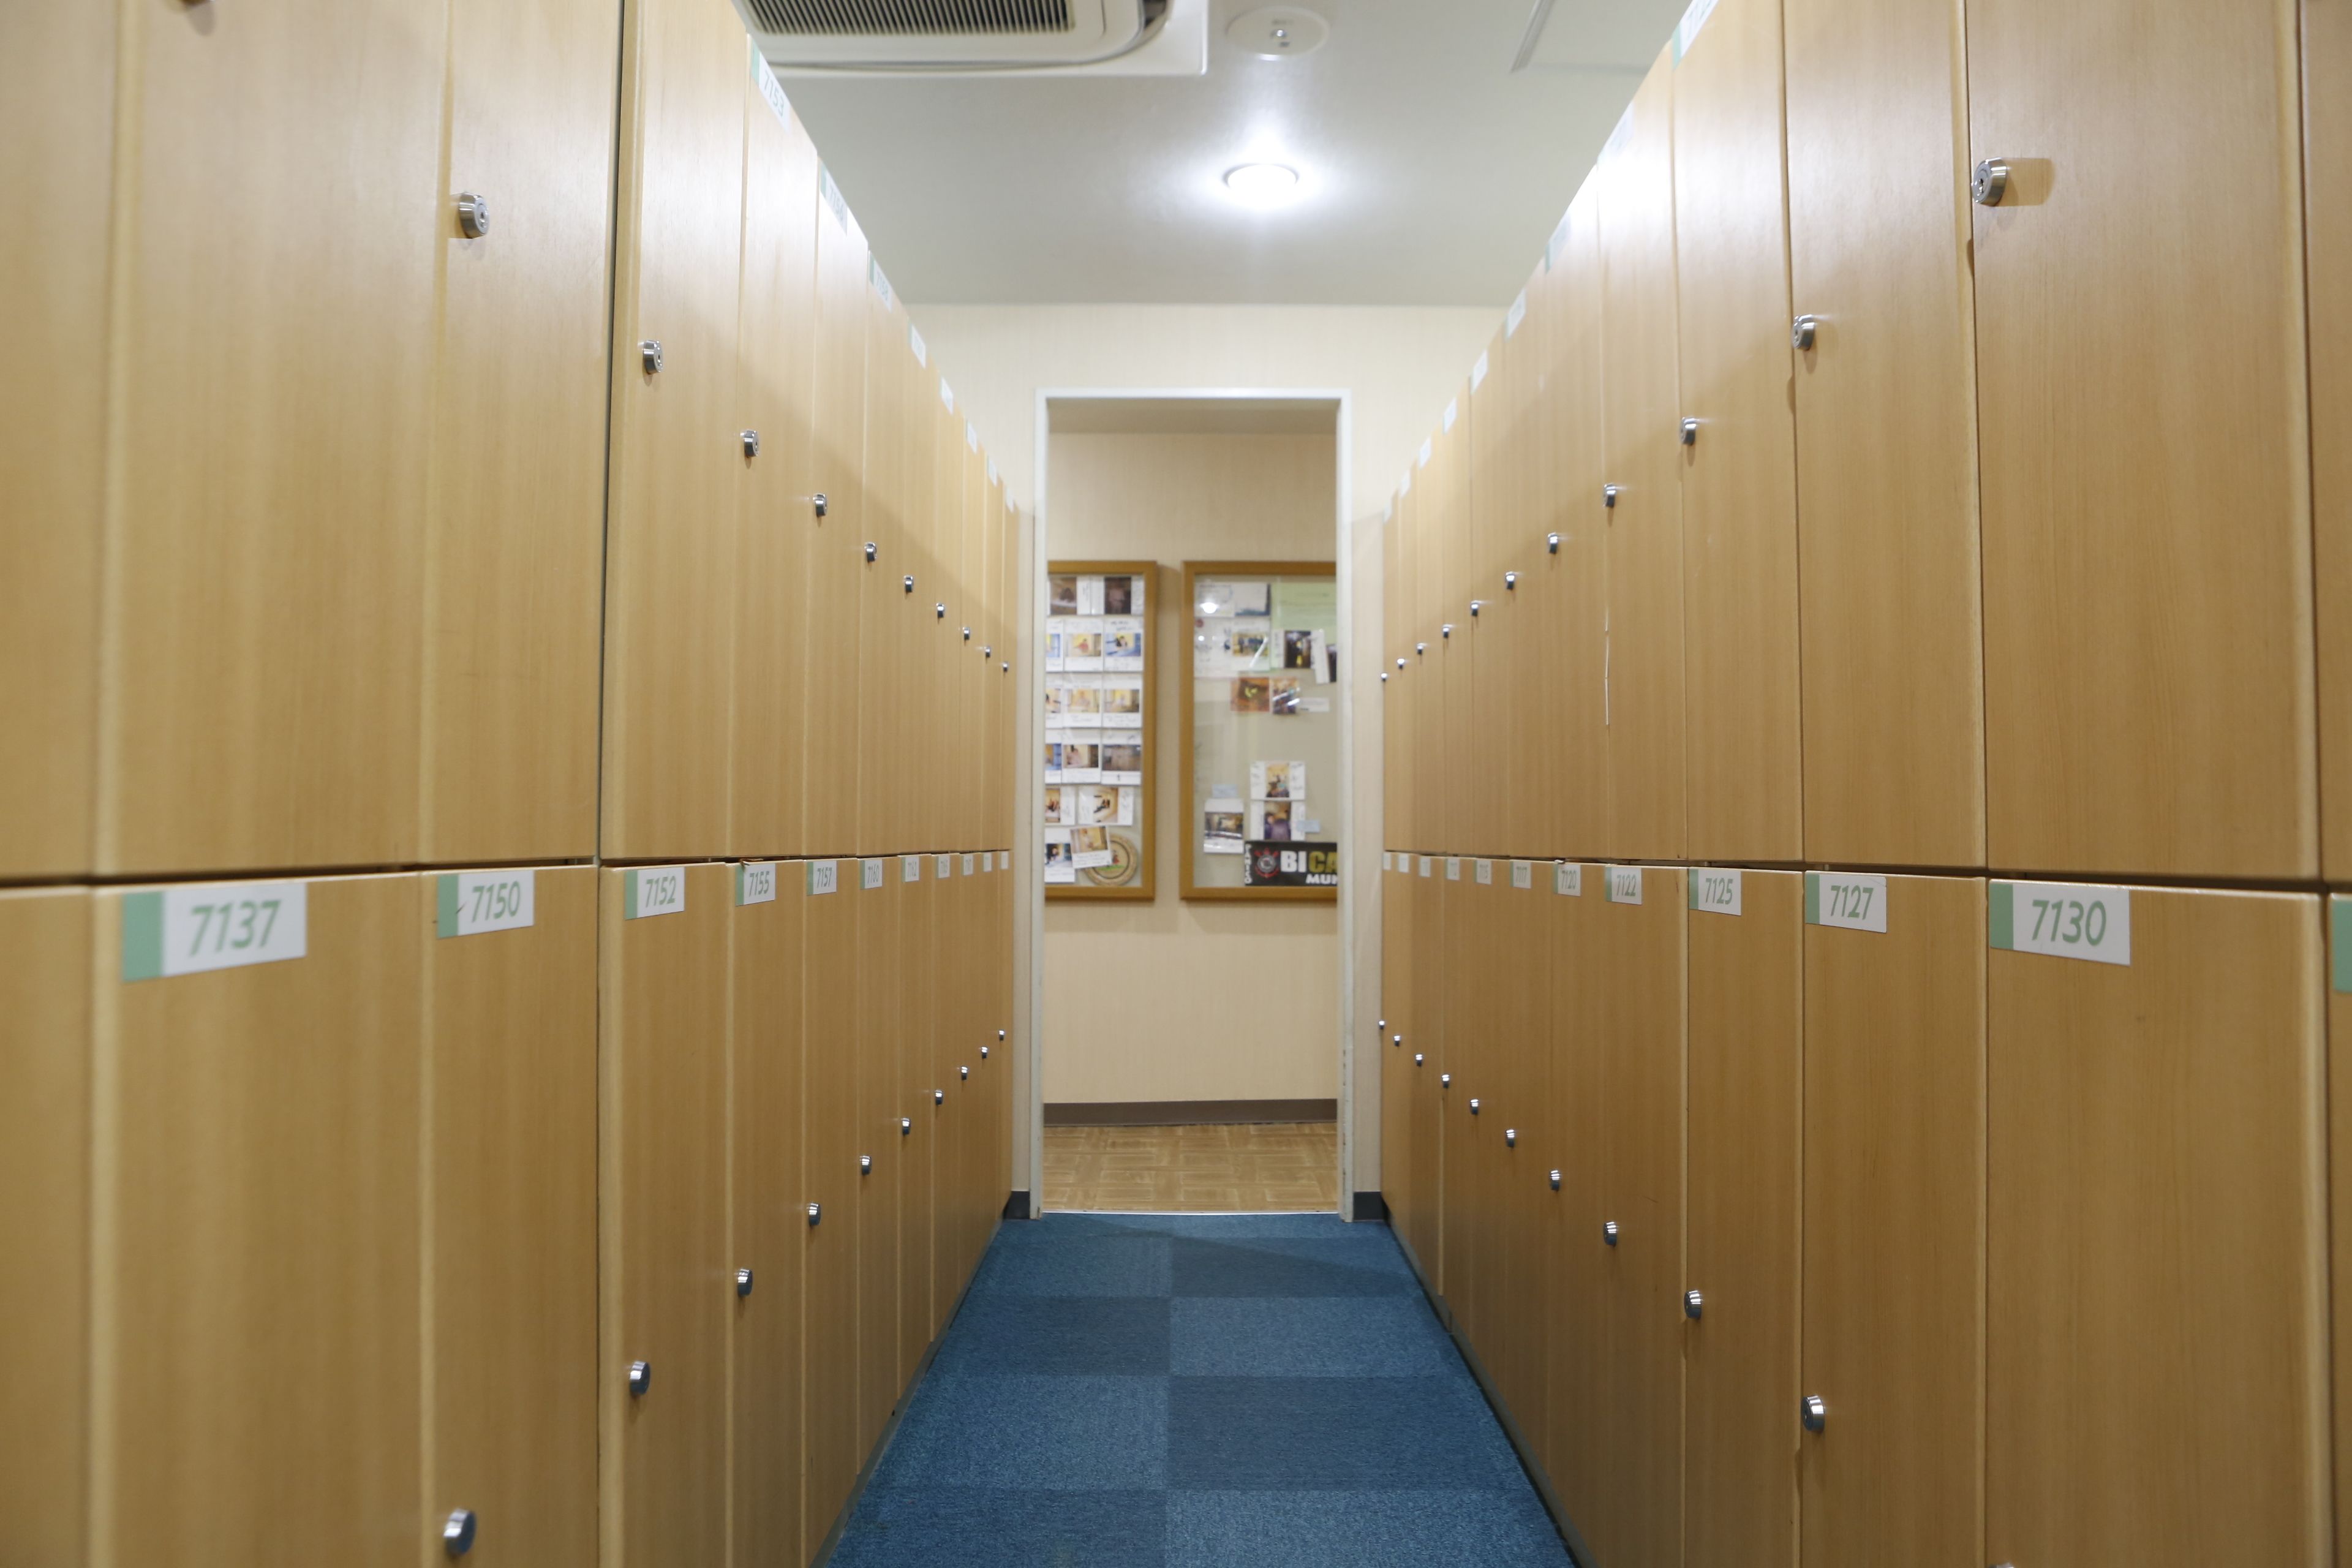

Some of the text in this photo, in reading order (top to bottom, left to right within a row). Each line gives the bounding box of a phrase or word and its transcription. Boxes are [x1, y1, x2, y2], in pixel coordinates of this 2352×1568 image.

[764, 69, 785, 118] 7153
[749, 871, 770, 897] 7155
[817, 867, 832, 888] 7157
[867, 863, 880, 884] 7160
[1561, 870, 1577, 890] 7120
[1616, 874, 1637, 896] 7122
[471, 881, 521, 923] 7150
[645, 876, 677, 908] 7152
[1705, 877, 1734, 905] 7125
[1830, 885, 1874, 920] 7127
[189, 899, 282, 957] 7137
[2031, 899, 2107, 946] 7130
